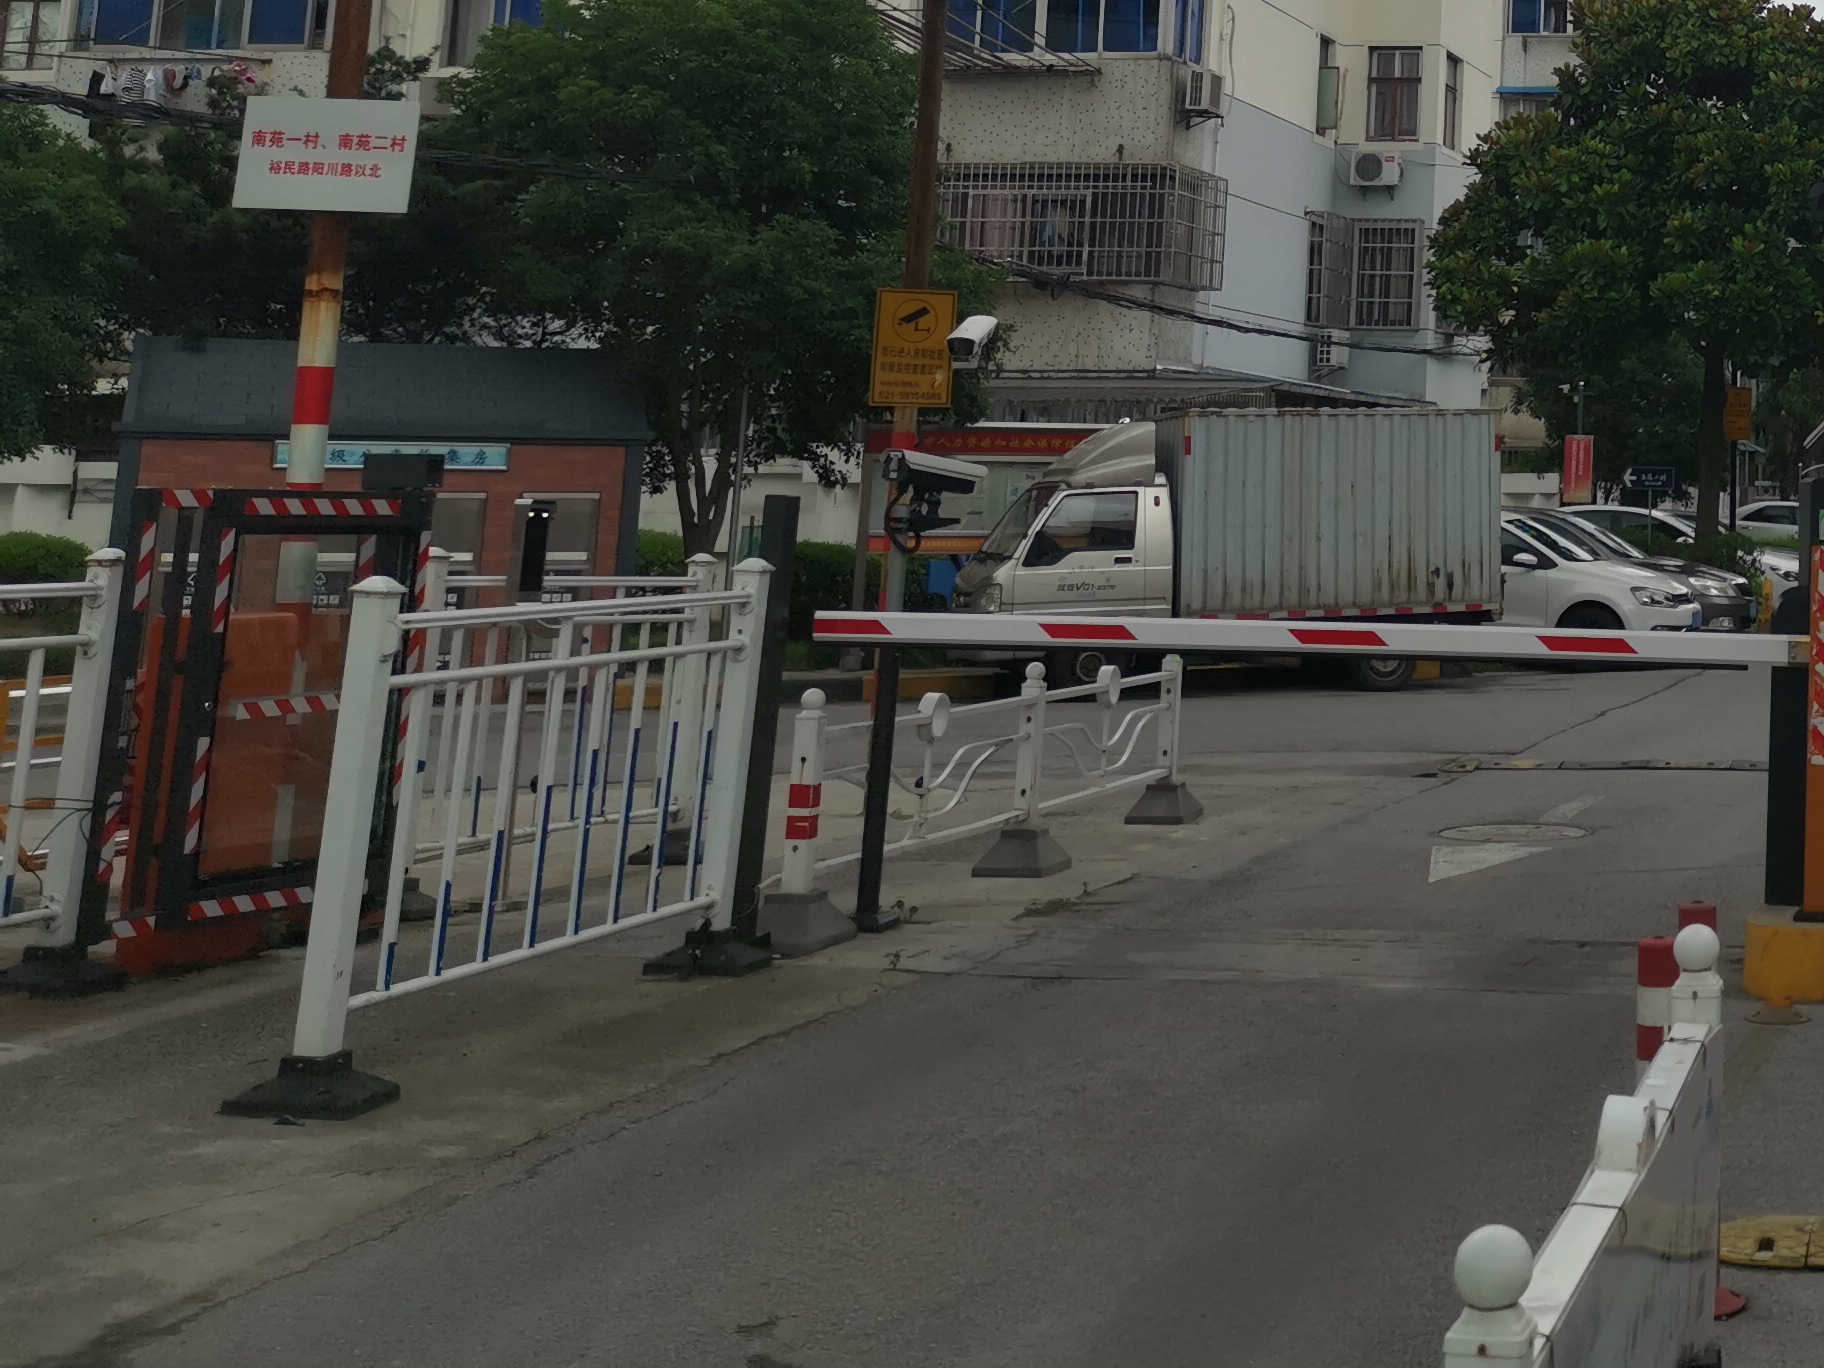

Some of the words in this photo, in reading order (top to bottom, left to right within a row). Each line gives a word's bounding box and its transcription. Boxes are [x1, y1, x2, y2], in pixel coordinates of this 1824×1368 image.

[251, 130, 407, 153] 南苑一村、南苑二村
[268, 159, 382, 179] 裕民路阳川路以北
